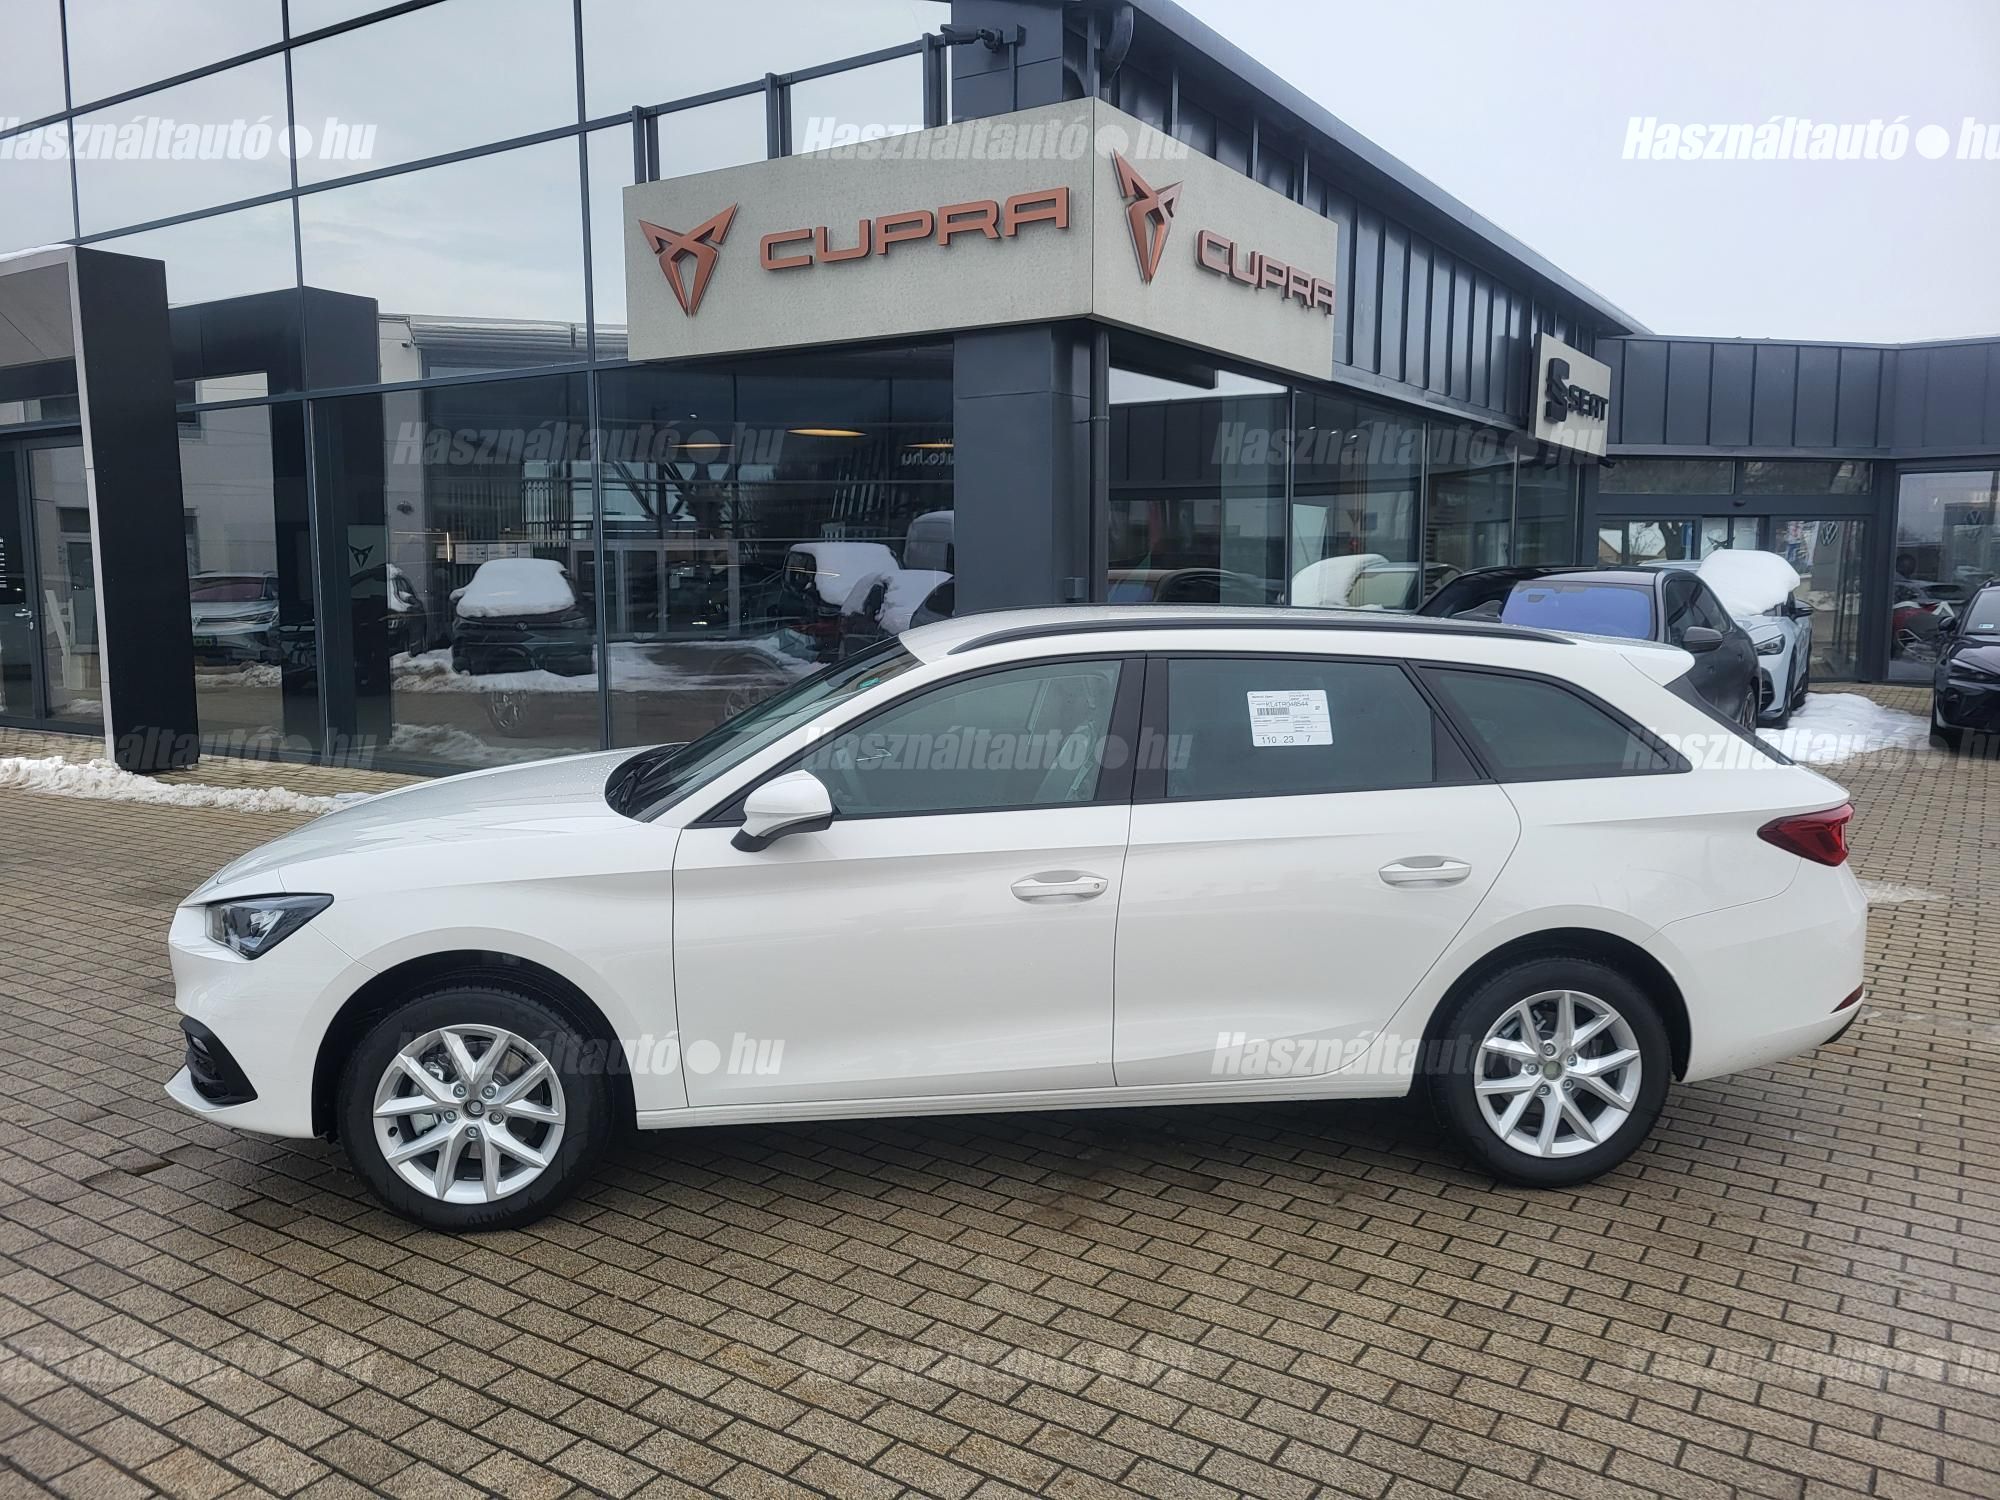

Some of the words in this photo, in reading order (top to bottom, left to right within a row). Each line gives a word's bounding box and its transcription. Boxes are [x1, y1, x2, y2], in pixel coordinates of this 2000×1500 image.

[760, 187, 1070, 271] CUPRA
[1195, 229, 1335, 315] CUPRA
[1568, 385, 1609, 421] SEAT
[1284, 735, 1294, 743] 23
